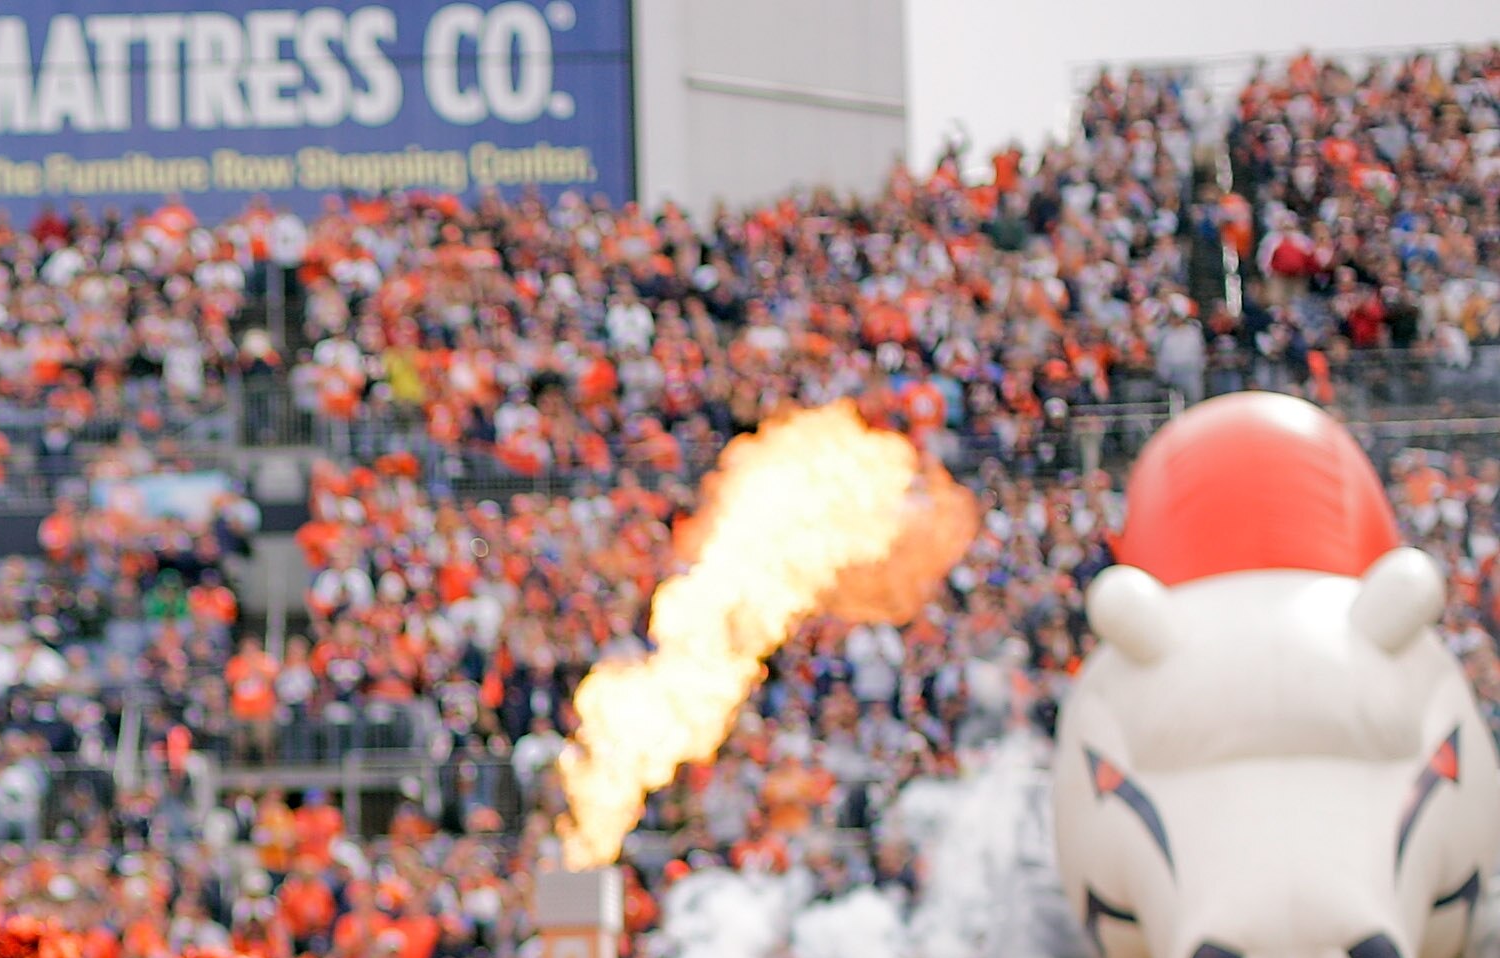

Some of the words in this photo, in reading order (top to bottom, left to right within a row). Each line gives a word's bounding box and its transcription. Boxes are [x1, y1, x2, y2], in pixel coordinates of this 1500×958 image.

[45, 150, 209, 194] Furniture
[214, 148, 297, 190] Row
[300, 144, 467, 195] Shopping
